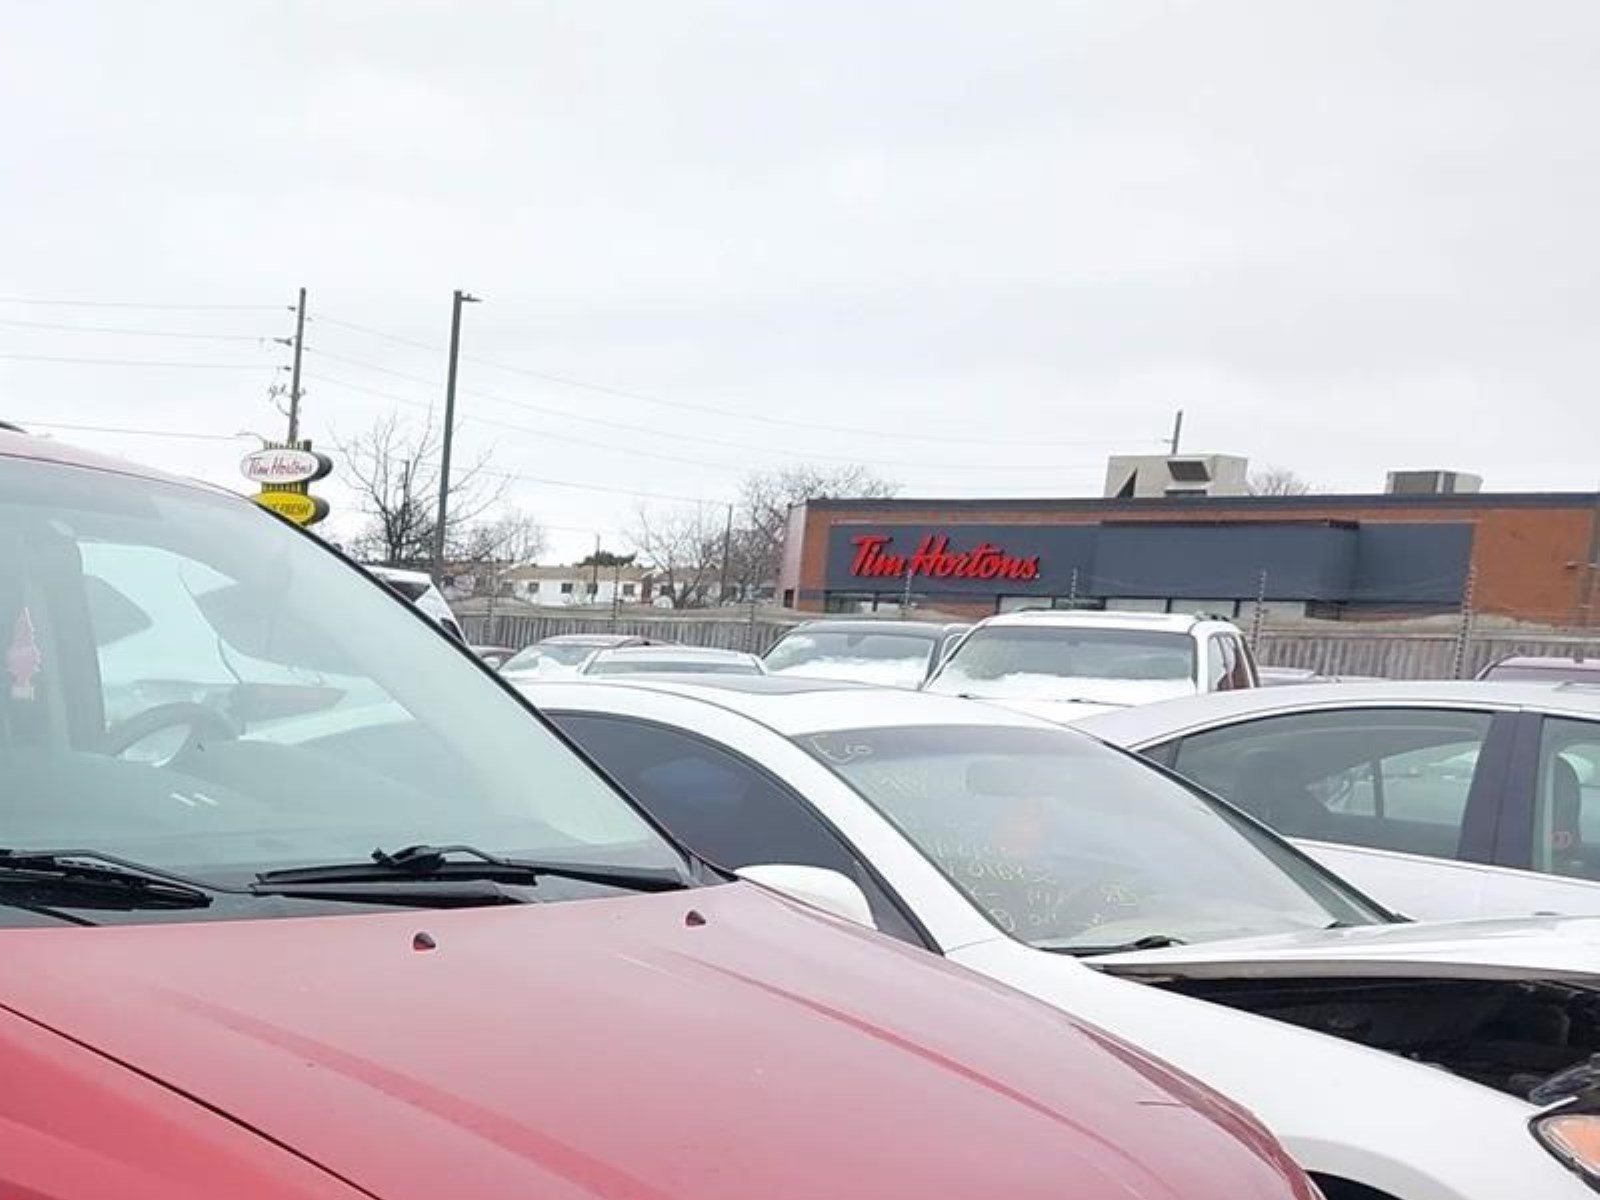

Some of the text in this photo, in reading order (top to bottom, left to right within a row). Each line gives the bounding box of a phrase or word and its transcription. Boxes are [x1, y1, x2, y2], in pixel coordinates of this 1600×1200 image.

[249, 456, 312, 476] Tim Hortons
[850, 533, 1039, 582] Tim Hortons
